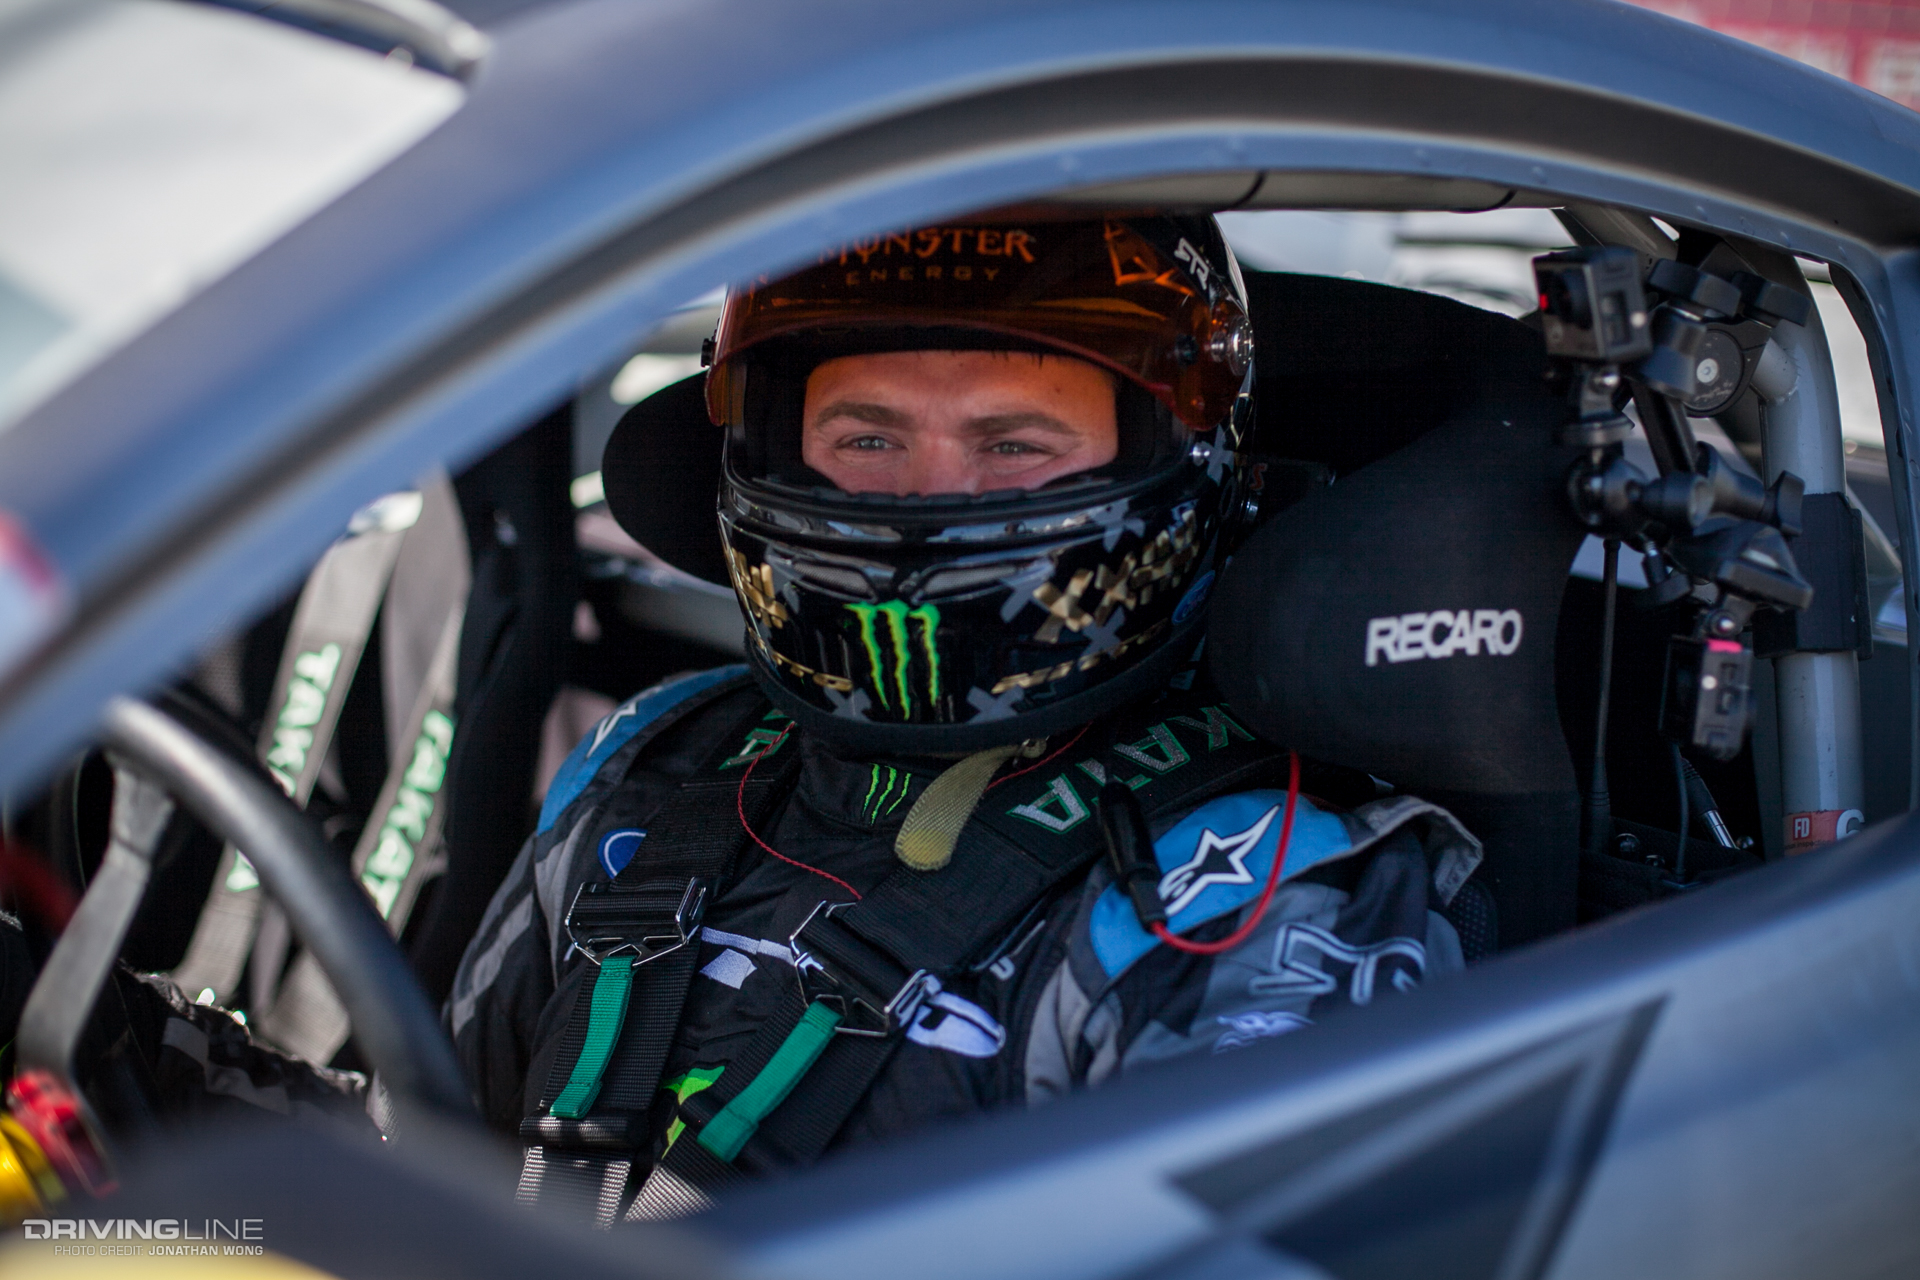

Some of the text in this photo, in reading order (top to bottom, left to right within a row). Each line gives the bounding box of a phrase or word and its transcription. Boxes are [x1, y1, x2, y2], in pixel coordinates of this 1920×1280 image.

[845, 265, 1000, 287] ENERGY
[1364, 608, 1524, 668] RECARO
[1794, 817, 1810, 839] FD
